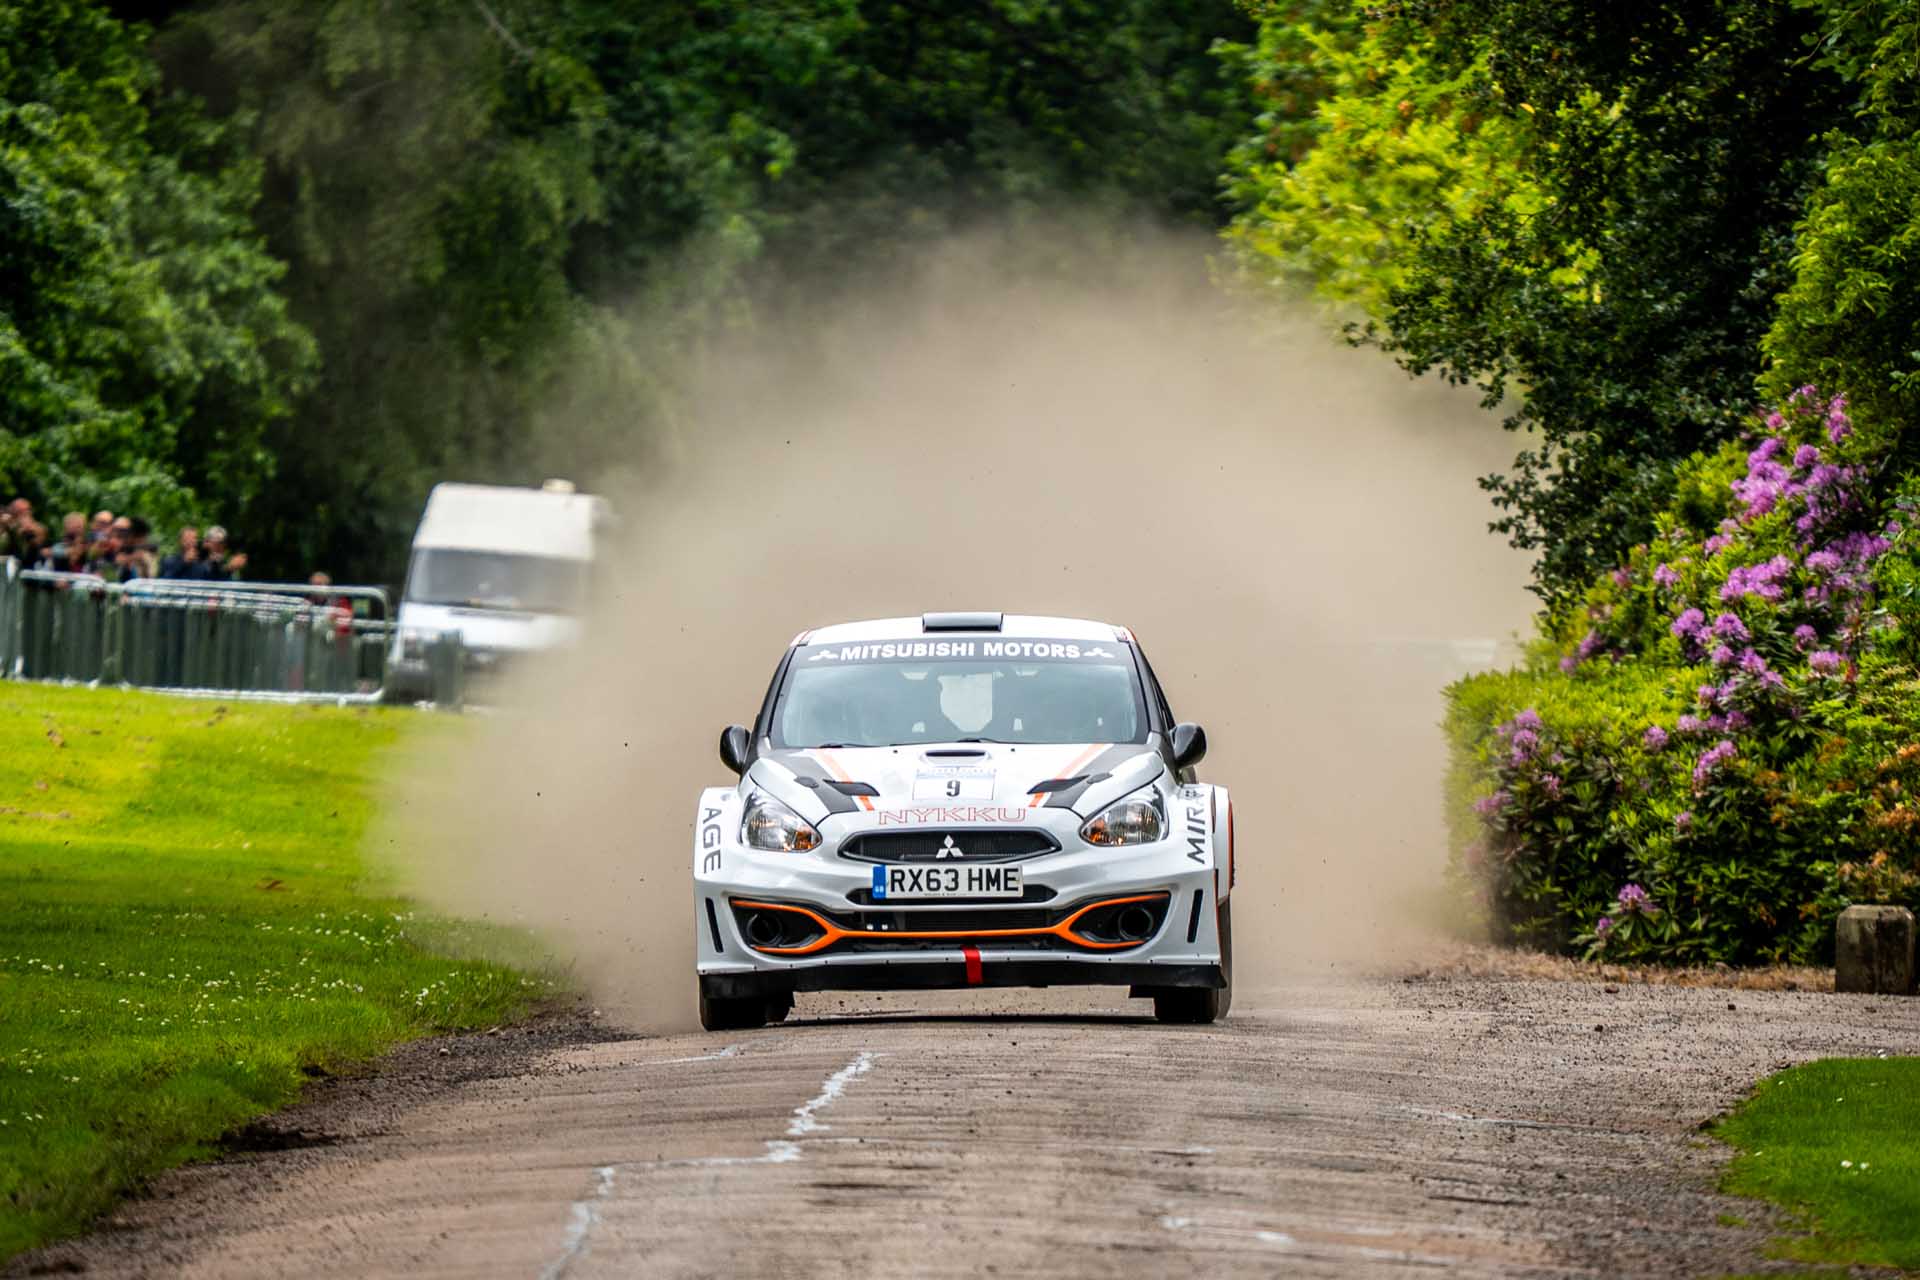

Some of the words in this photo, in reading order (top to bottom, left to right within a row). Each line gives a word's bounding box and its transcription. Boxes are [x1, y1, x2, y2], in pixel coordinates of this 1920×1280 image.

[840, 642, 975, 661] MITSUBISHI
[983, 641, 1081, 659] MOTORS
[946, 779, 961, 797] 9
[878, 807, 1027, 826] NYKKU
[703, 807, 722, 874] AGE
[890, 868, 960, 893] RX63
[967, 867, 1020, 892] HME
